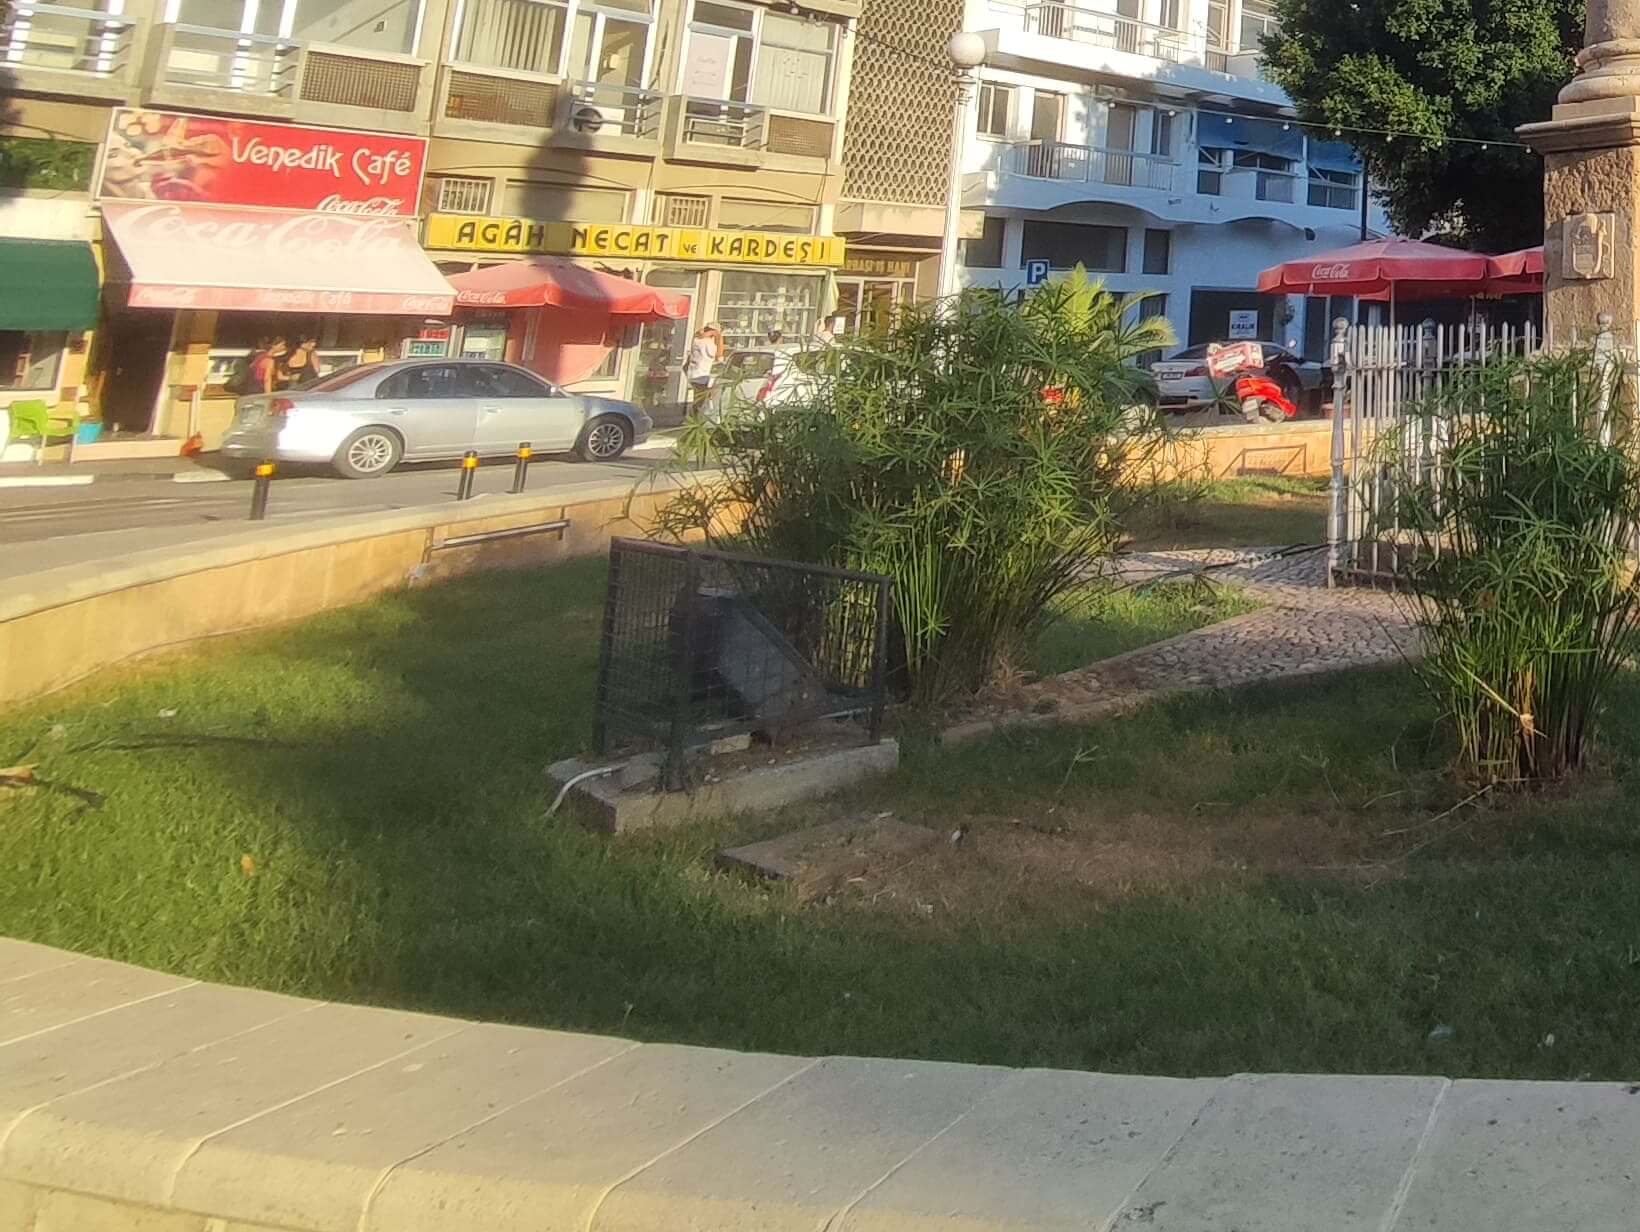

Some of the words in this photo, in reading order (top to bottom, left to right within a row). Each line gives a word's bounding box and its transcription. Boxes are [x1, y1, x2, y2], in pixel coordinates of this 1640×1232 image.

[231, 136, 345, 178] Venedik
[351, 150, 412, 186] Café
[456, 219, 546, 249] AGÂH
[570, 226, 669, 255] NECAT
[1031, 262, 1046, 283] P
